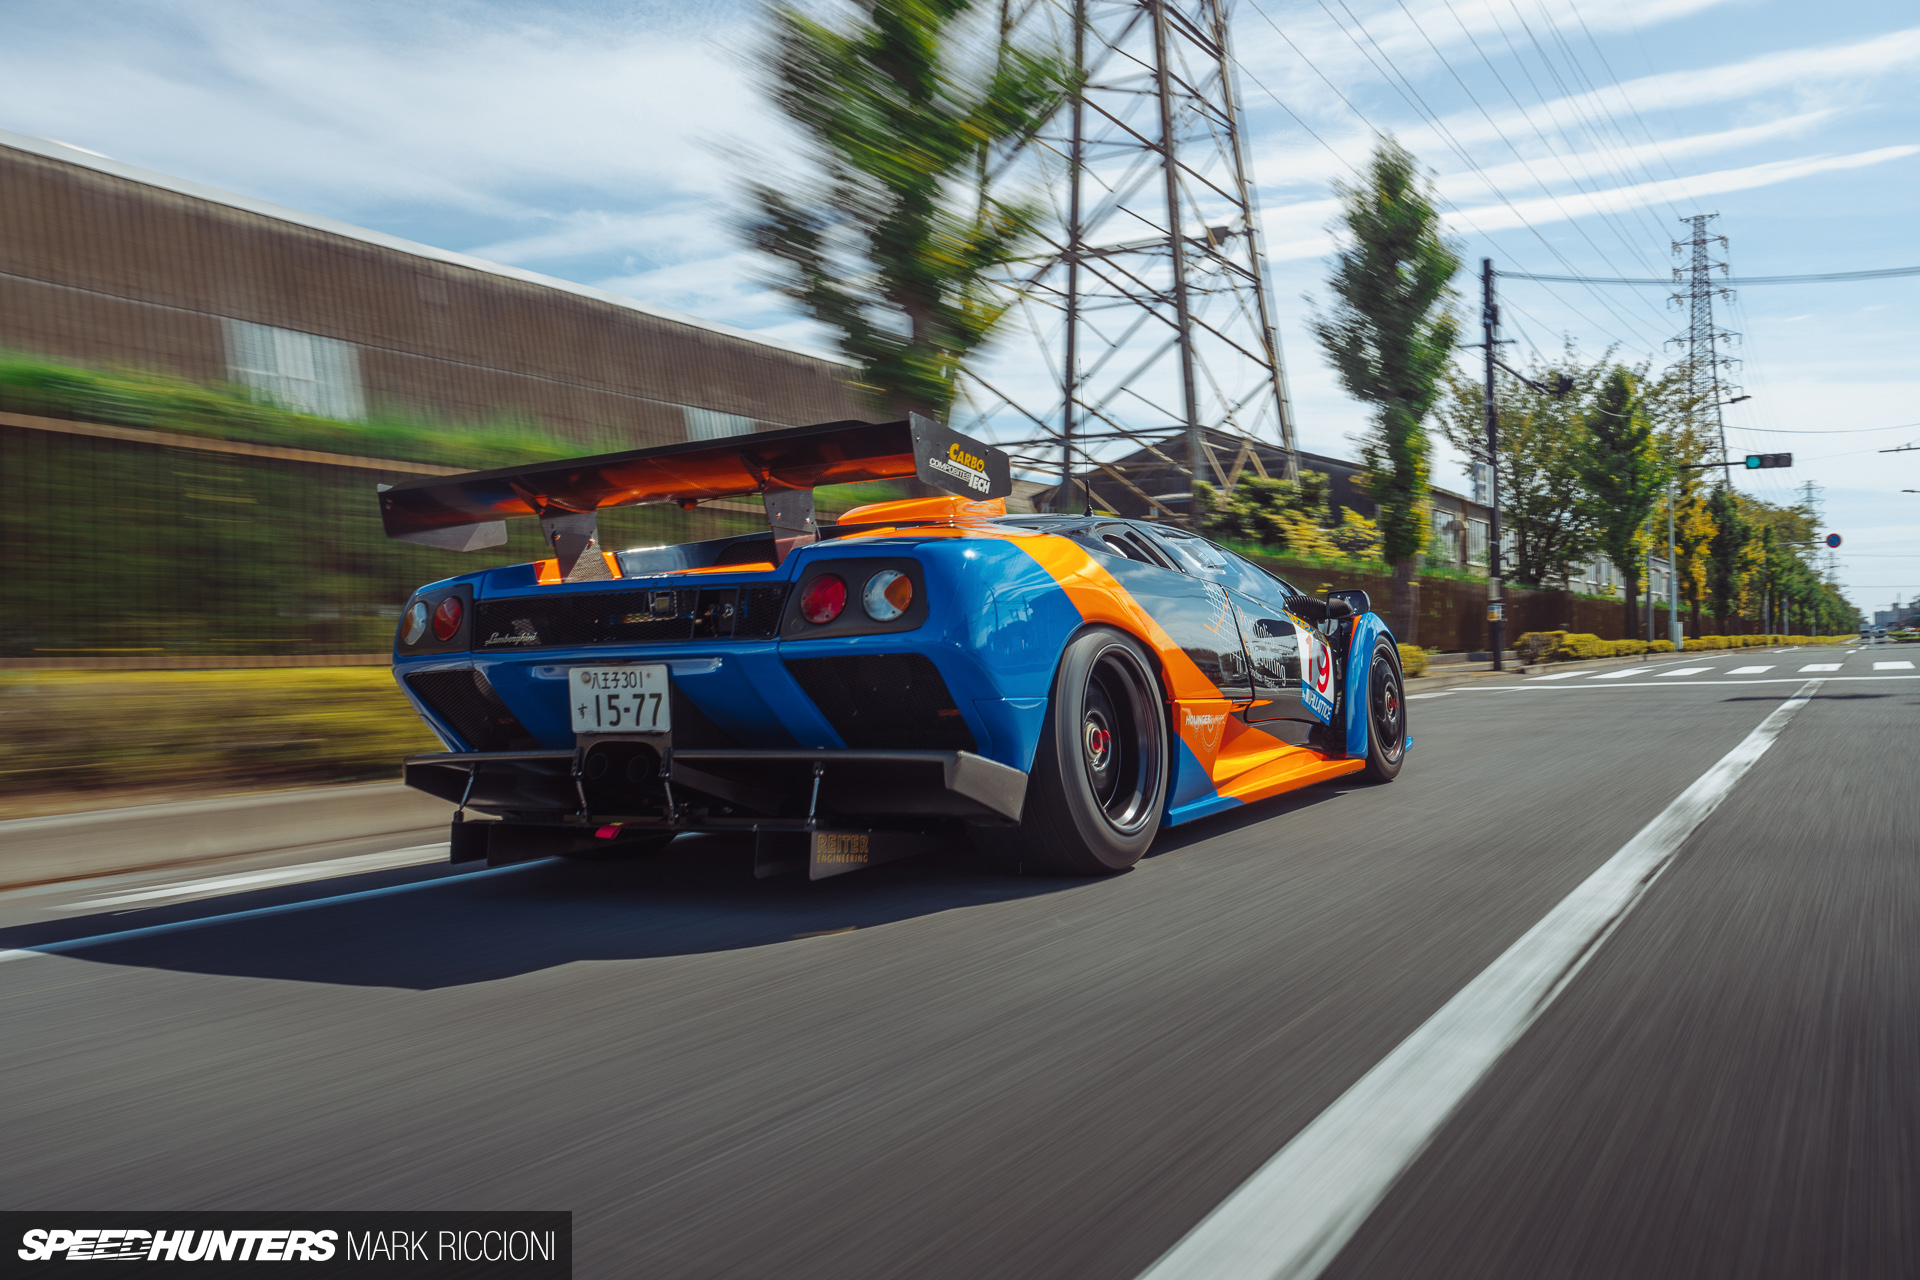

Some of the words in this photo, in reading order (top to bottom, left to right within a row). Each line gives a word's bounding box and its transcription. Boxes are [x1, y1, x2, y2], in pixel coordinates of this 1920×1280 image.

[929, 457, 971, 480] COMPOSITES
[949, 443, 985, 472] CARBO
[968, 472, 991, 494] TECH
[484, 631, 537, 646] Lamborghini
[1306, 634, 1330, 693] 19
[595, 693, 662, 727] 15-77
[817, 834, 869, 854] REITER
[816, 853, 869, 863] ENGINEERING
